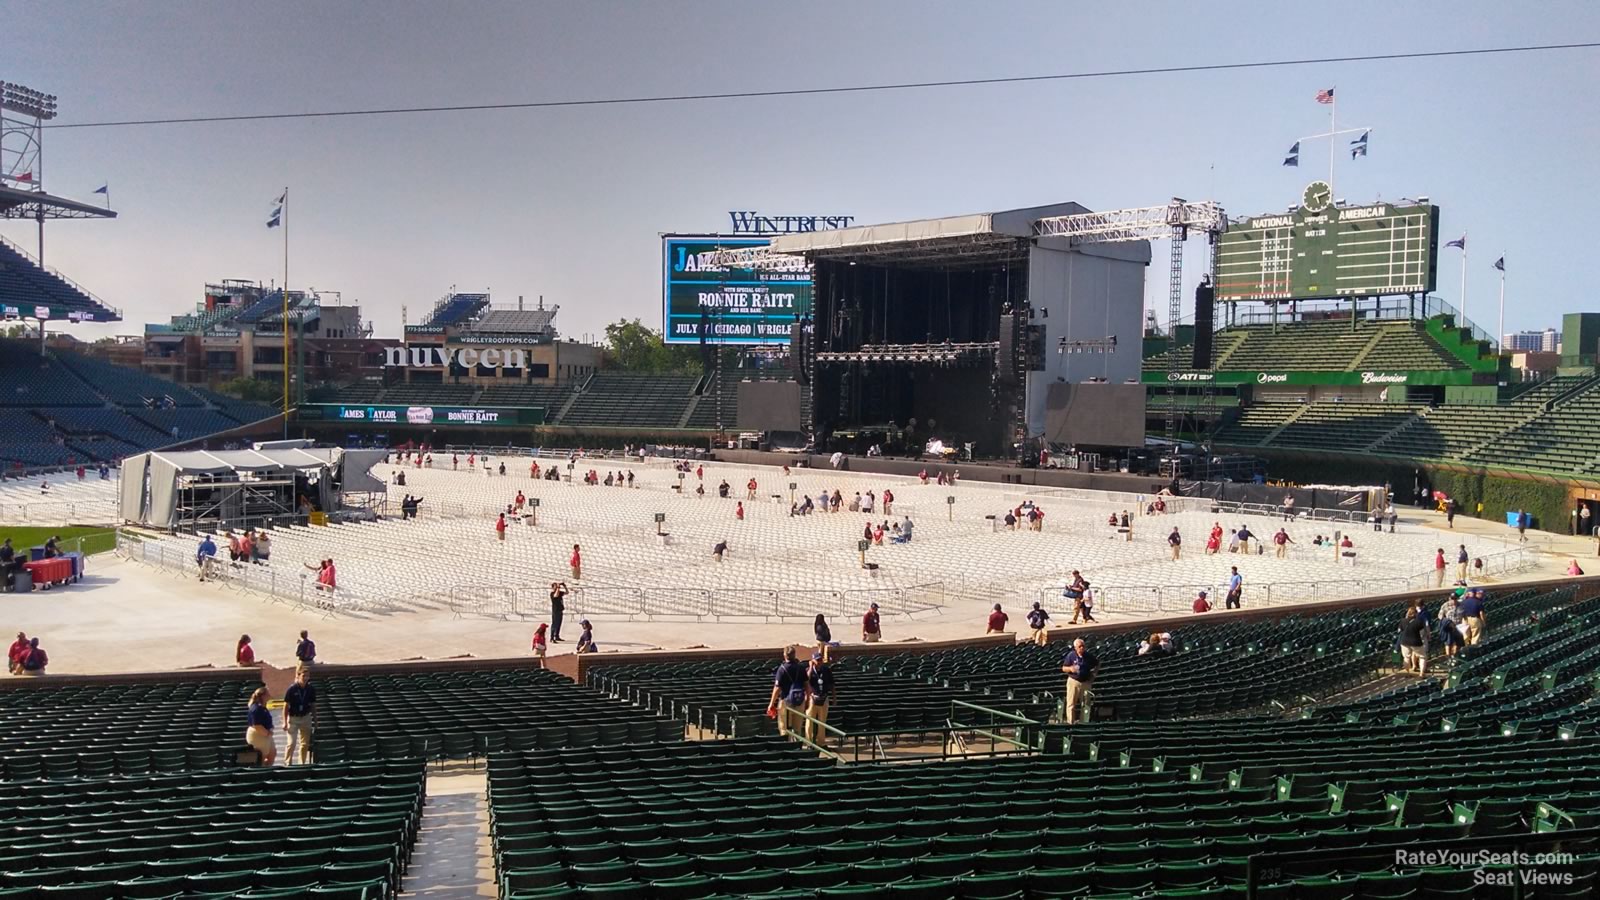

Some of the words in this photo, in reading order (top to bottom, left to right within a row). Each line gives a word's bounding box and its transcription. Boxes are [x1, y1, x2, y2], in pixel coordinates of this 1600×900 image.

[1338, 206, 1386, 220] AMERICAN
[1252, 216, 1294, 229] NATIONAL
[698, 293, 748, 307] BONNIE
[751, 293, 795, 308] RAITT
[675, 324, 699, 333] JULY
[714, 324, 752, 334] CHICAGO
[384, 346, 528, 369] nuveen
[1267, 374, 1287, 383] pepsi
[1361, 372, 1407, 384] Budweiser
[339, 406, 365, 418] JAMES
[367, 407, 397, 419] TAYLOR
[448, 412, 475, 420] BONNIE
[475, 413, 498, 421] RAITT
[1260, 867, 1281, 880] 235
